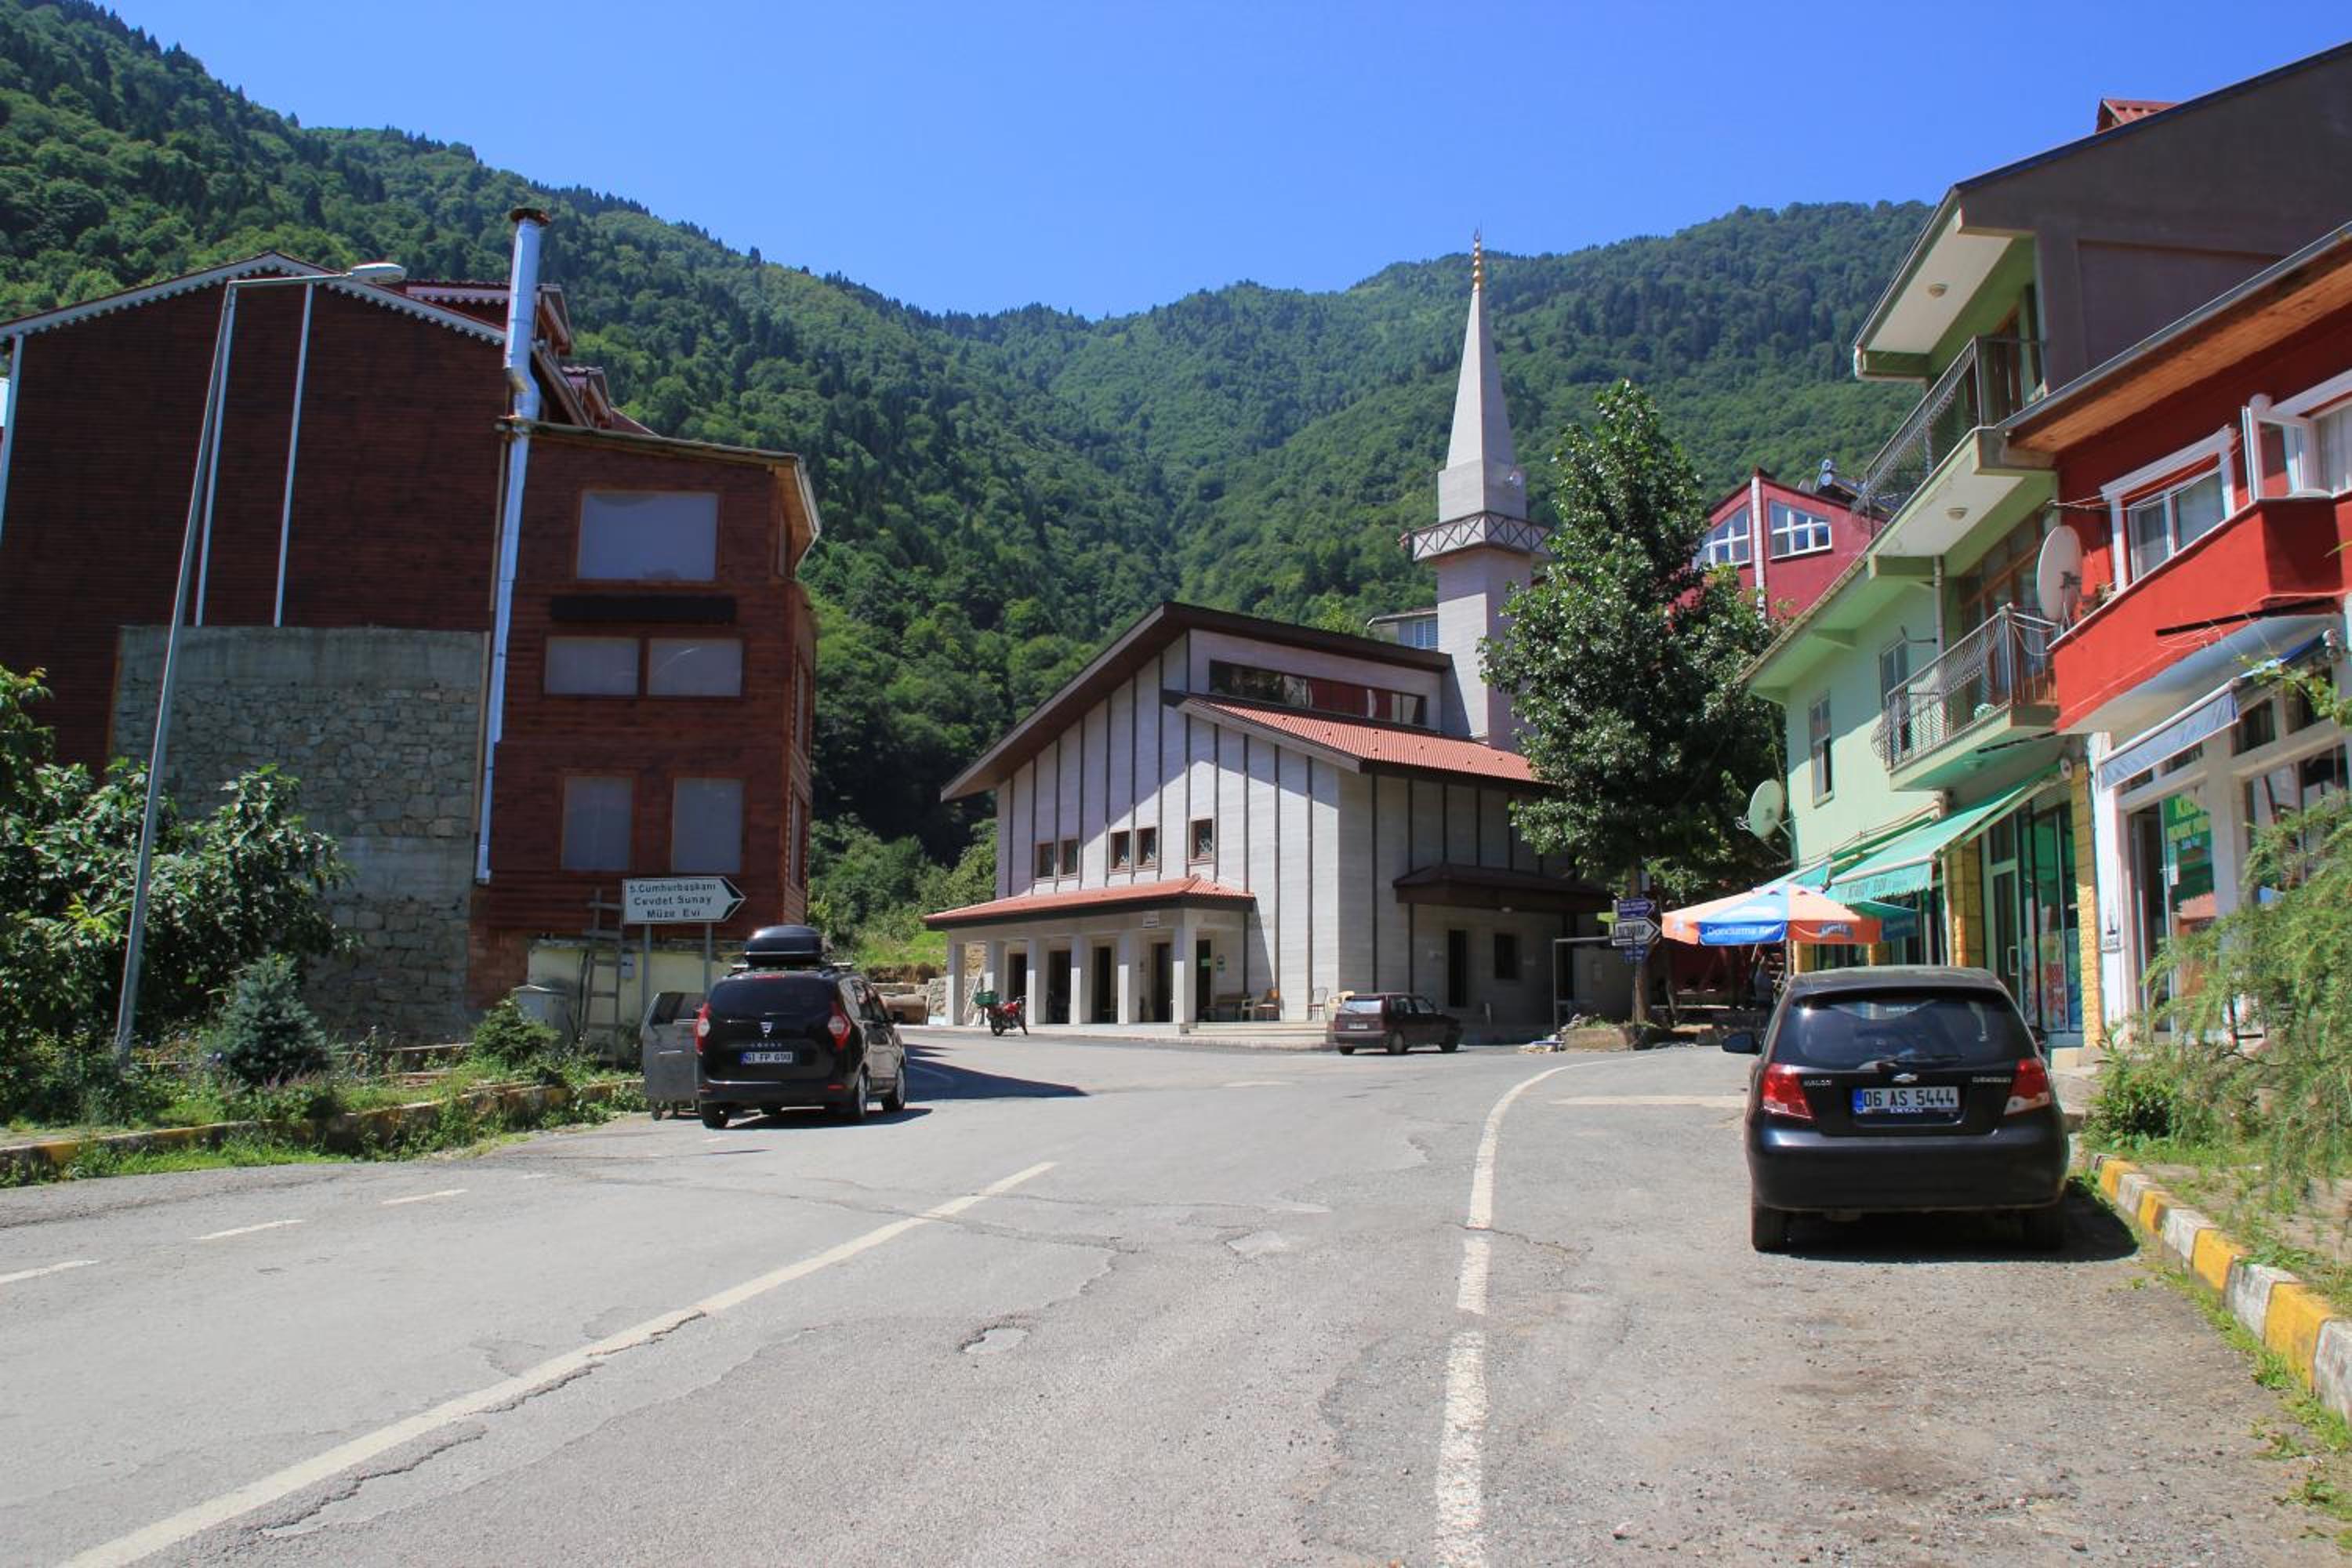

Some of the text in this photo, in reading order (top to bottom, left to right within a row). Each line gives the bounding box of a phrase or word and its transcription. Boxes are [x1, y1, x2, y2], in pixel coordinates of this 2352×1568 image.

[634, 895, 713, 906] Cevdet Sunay
[647, 908, 701, 918] Müze Evi
[1864, 1090, 1955, 1107] 06 AS 5444
